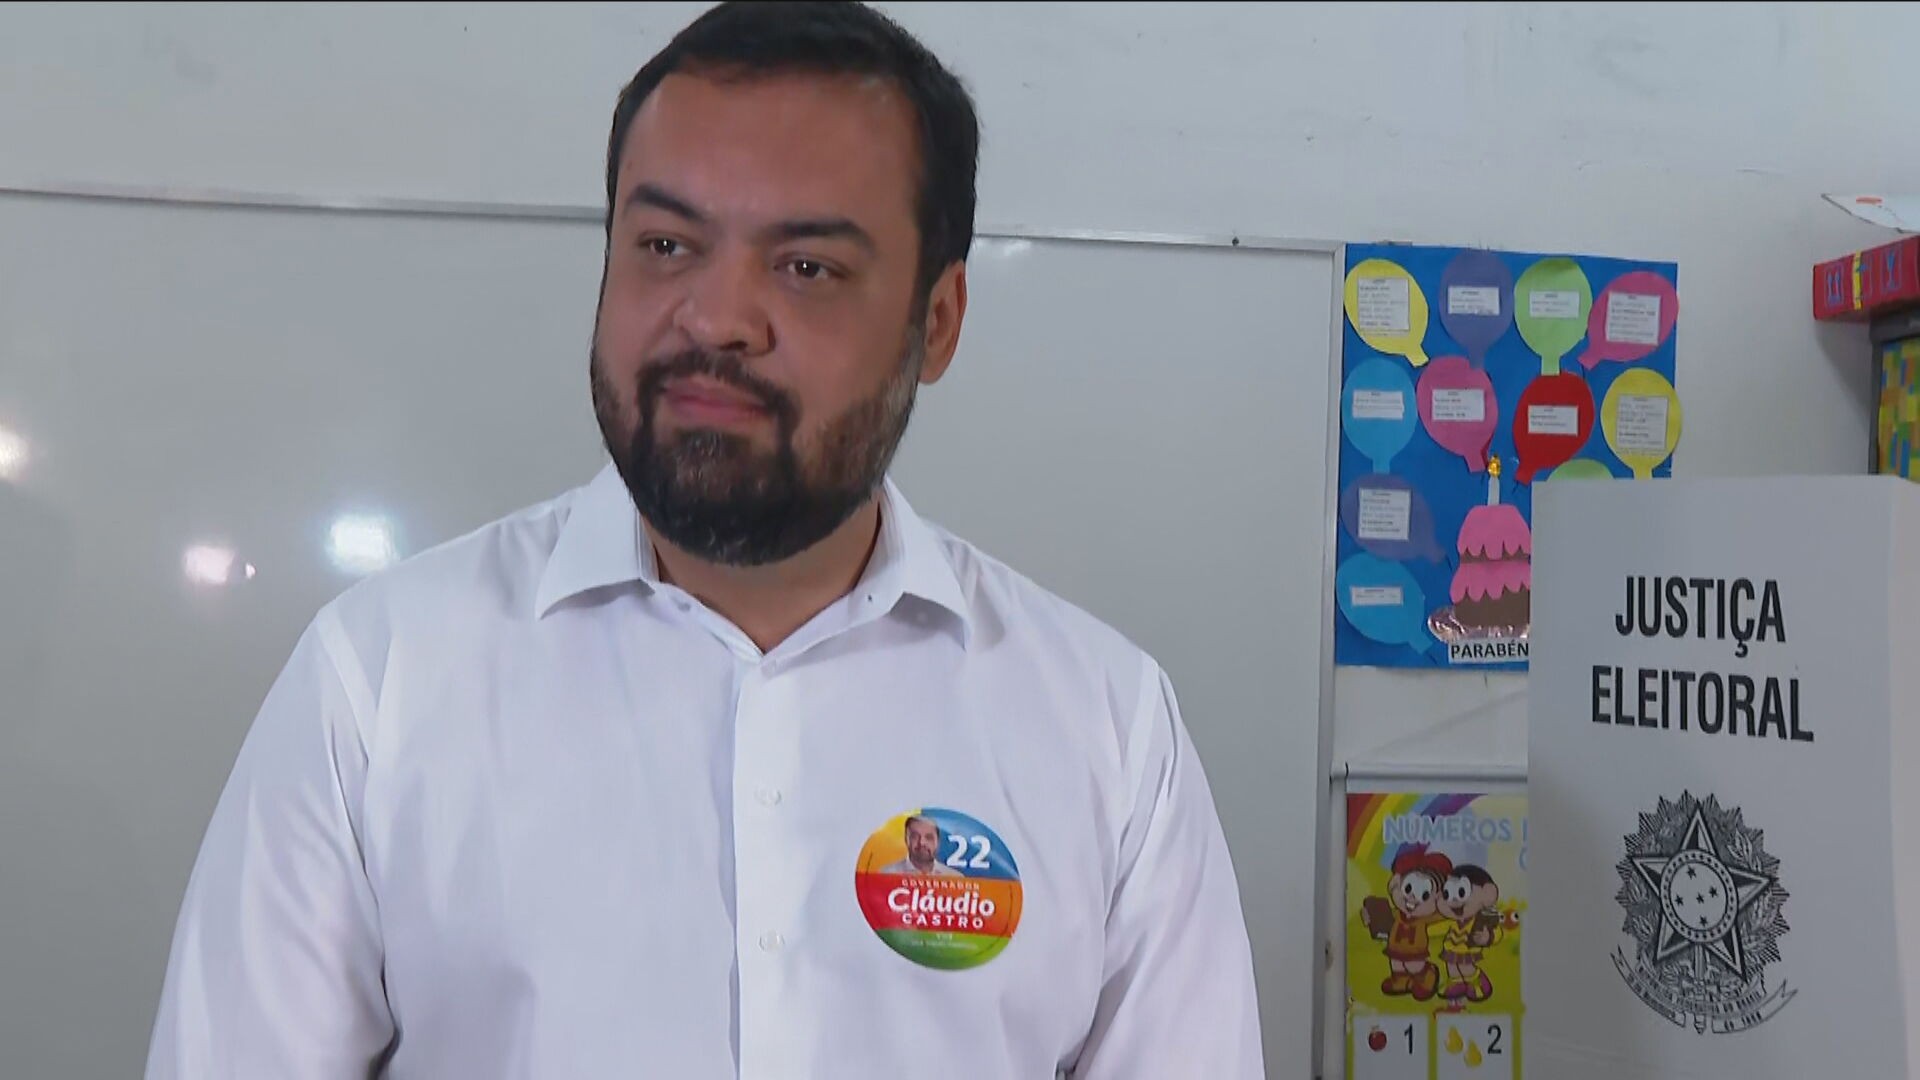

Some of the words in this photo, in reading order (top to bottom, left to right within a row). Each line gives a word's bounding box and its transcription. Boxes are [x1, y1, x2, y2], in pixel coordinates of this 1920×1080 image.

[1615, 576, 1786, 658] JUSTIÇA
[1592, 665, 1814, 742] ELEITORAL
[946, 835, 991, 869] 22
[901, 879, 980, 891] GOVERNADOR
[888, 887, 995, 917] Cláudio
[902, 913, 984, 929] CASTRO
[1404, 1024, 1413, 1054] 1
[1487, 1024, 1502, 1054] 2
